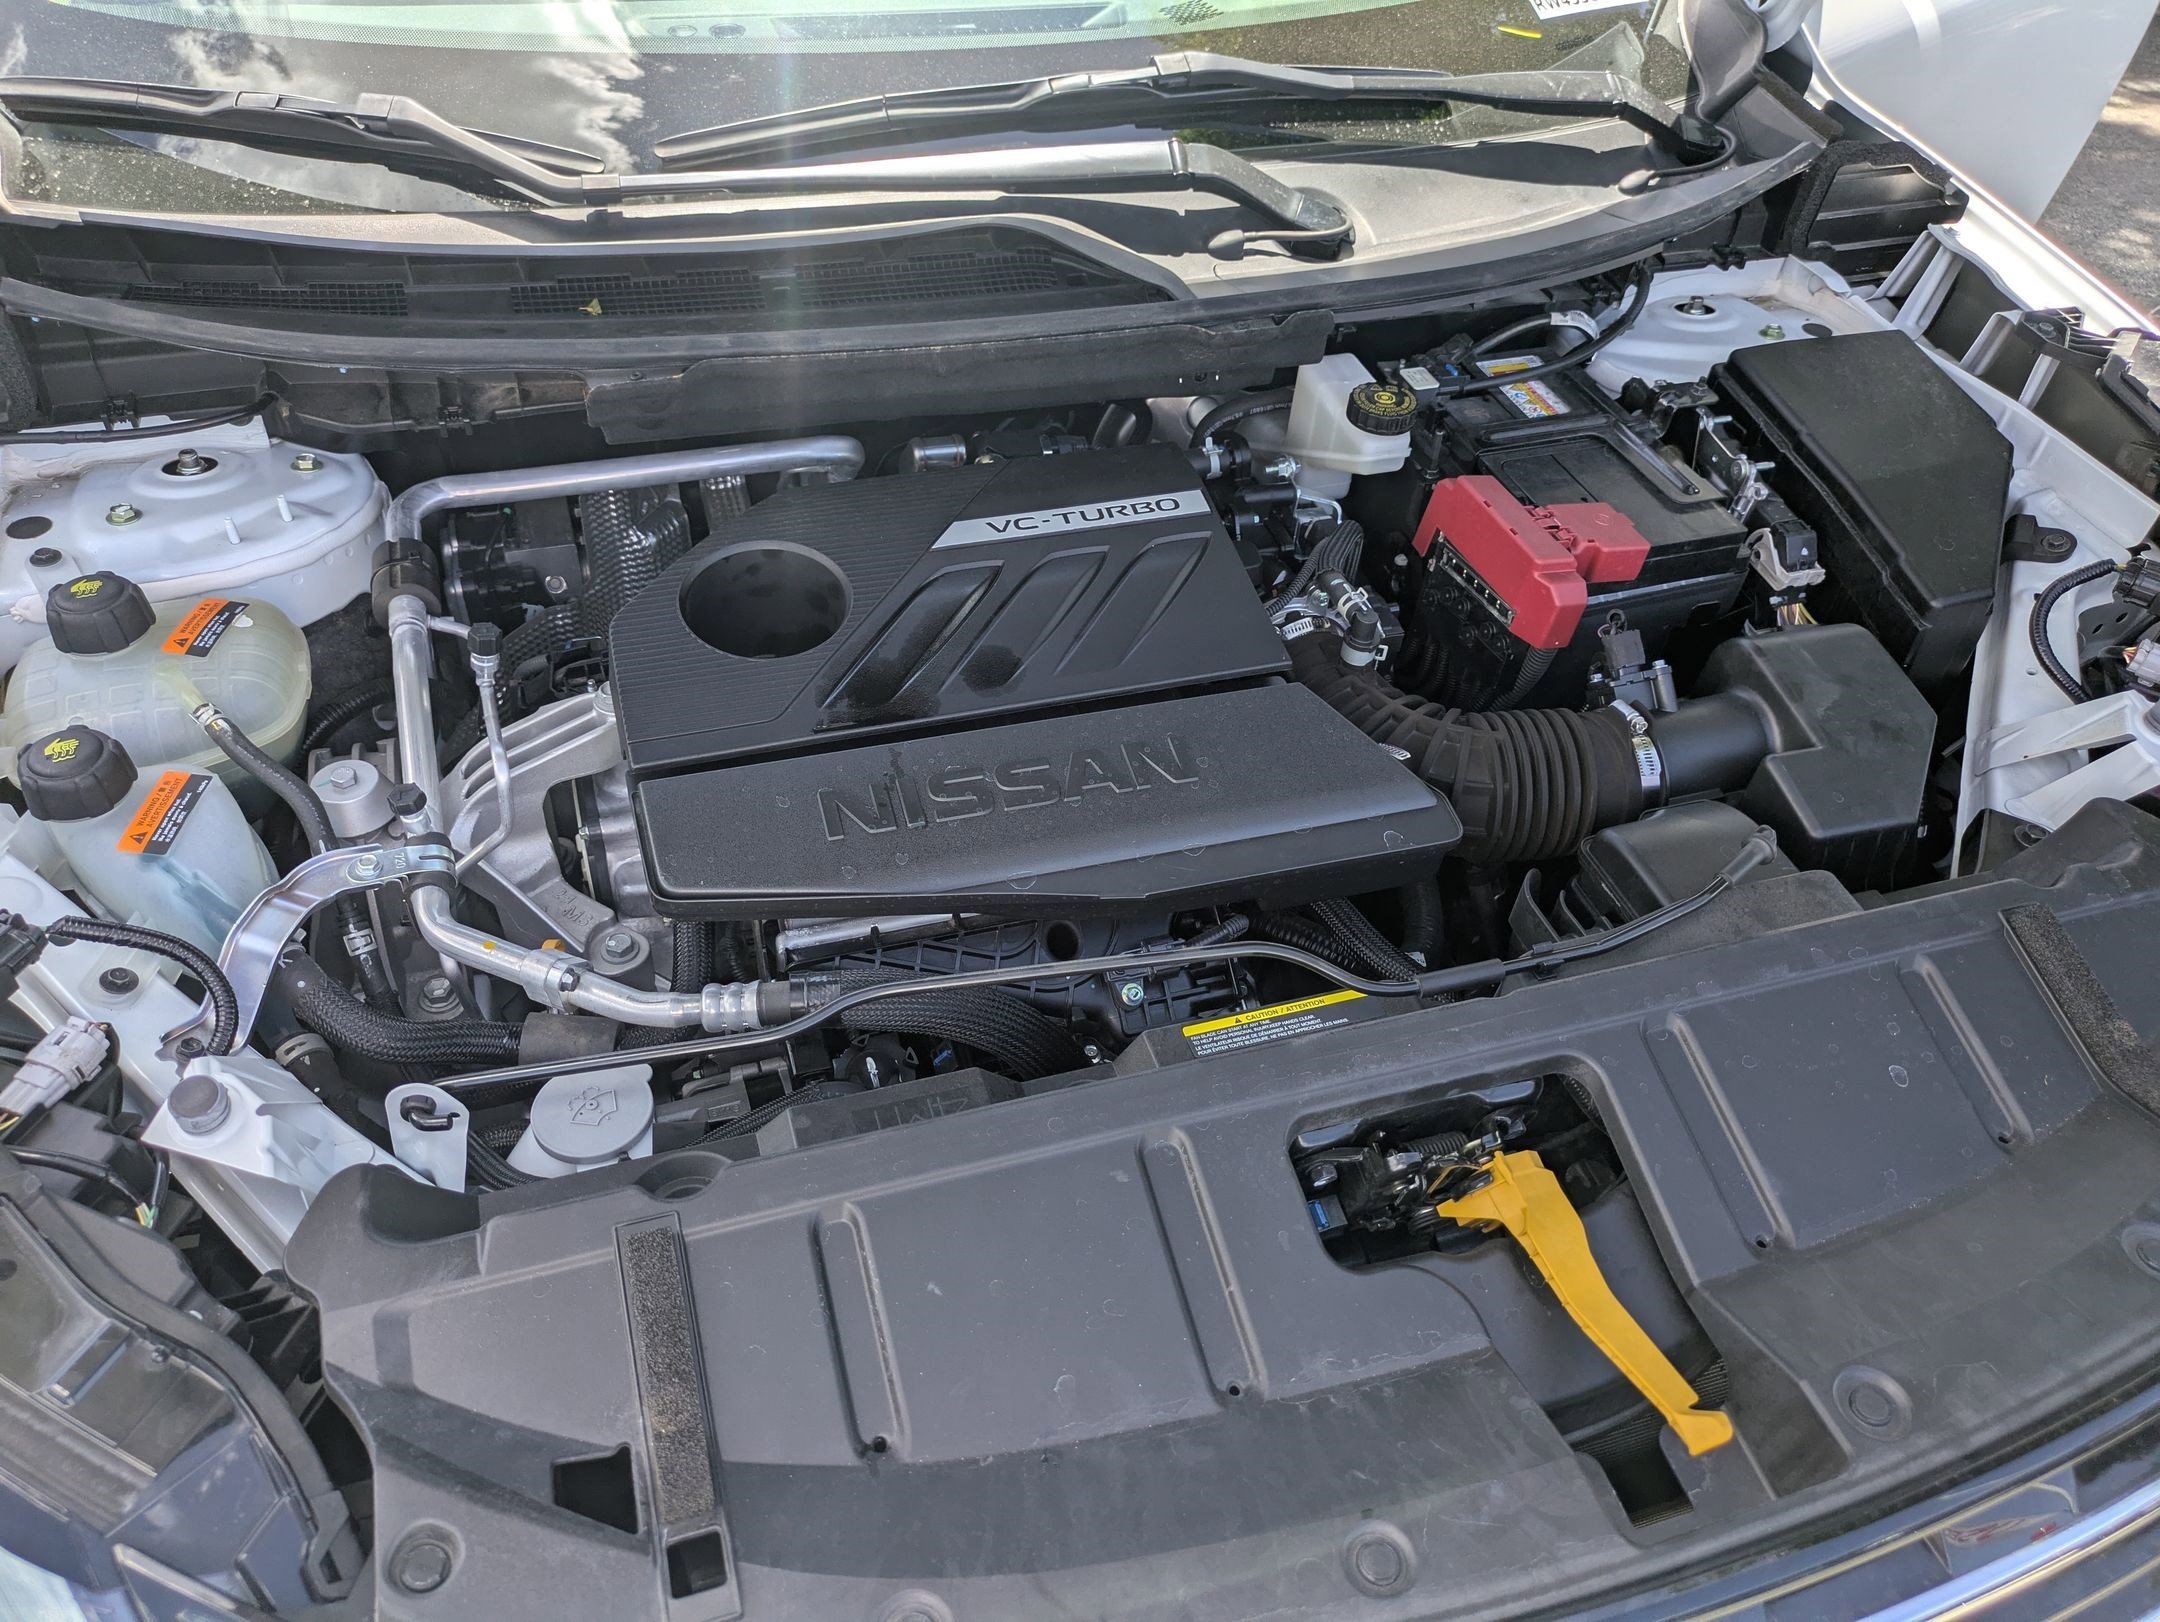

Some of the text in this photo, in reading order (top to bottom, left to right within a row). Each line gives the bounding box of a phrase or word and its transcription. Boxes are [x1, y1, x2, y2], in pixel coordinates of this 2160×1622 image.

[985, 498, 1180, 533] VC-TURBO
[146, 778, 183, 827] AVERTISSEMENT
[817, 732, 1199, 841] NISSAN
[136, 797, 160, 826] WARNING
[1245, 1009, 1279, 1021] CAUTION
[1286, 998, 1326, 1013] ATTENTION
